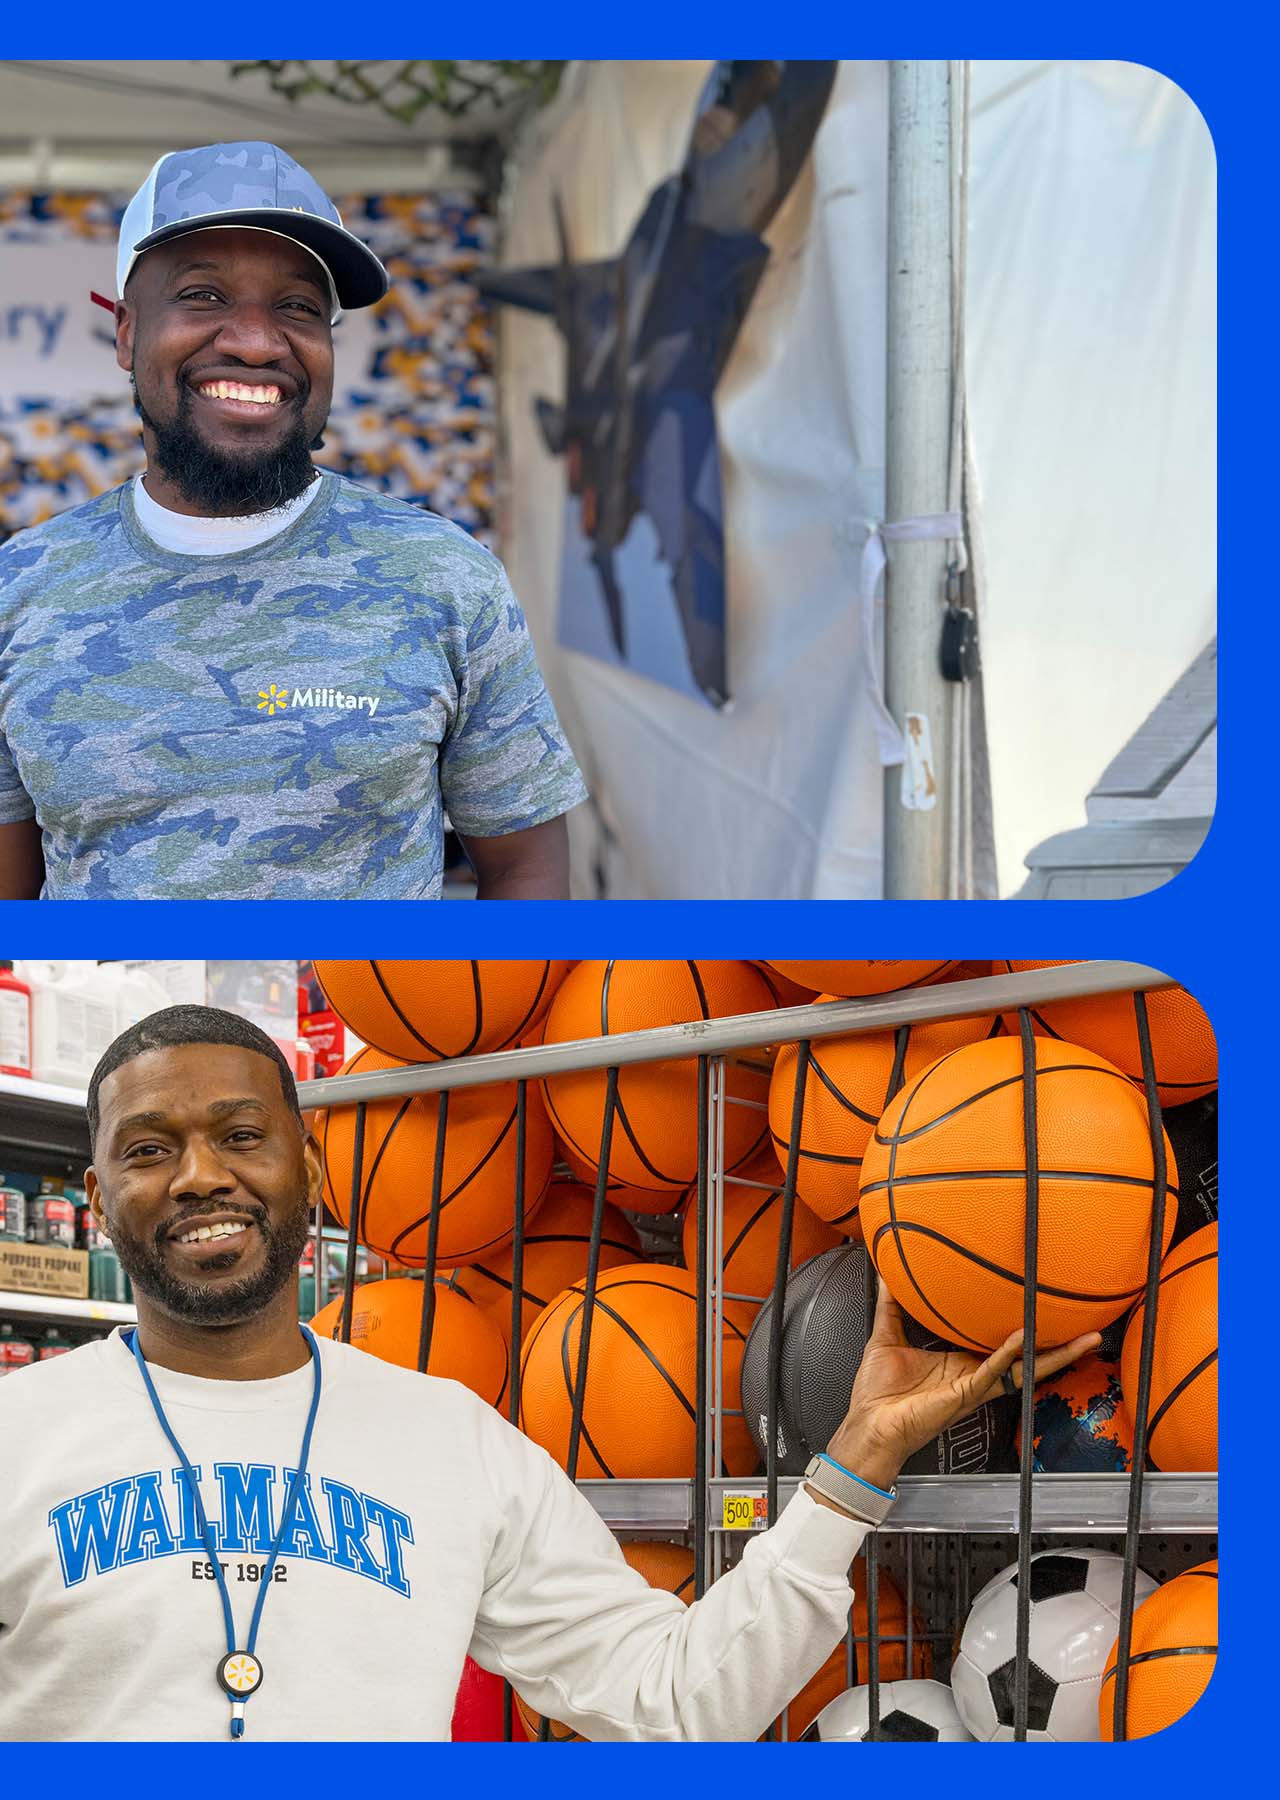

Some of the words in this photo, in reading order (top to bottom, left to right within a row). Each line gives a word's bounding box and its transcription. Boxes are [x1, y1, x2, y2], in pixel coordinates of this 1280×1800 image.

[291, 688, 380, 716] Military
[48, 1462, 415, 1599] WALMART
[192, 1561, 229, 1580] EST
